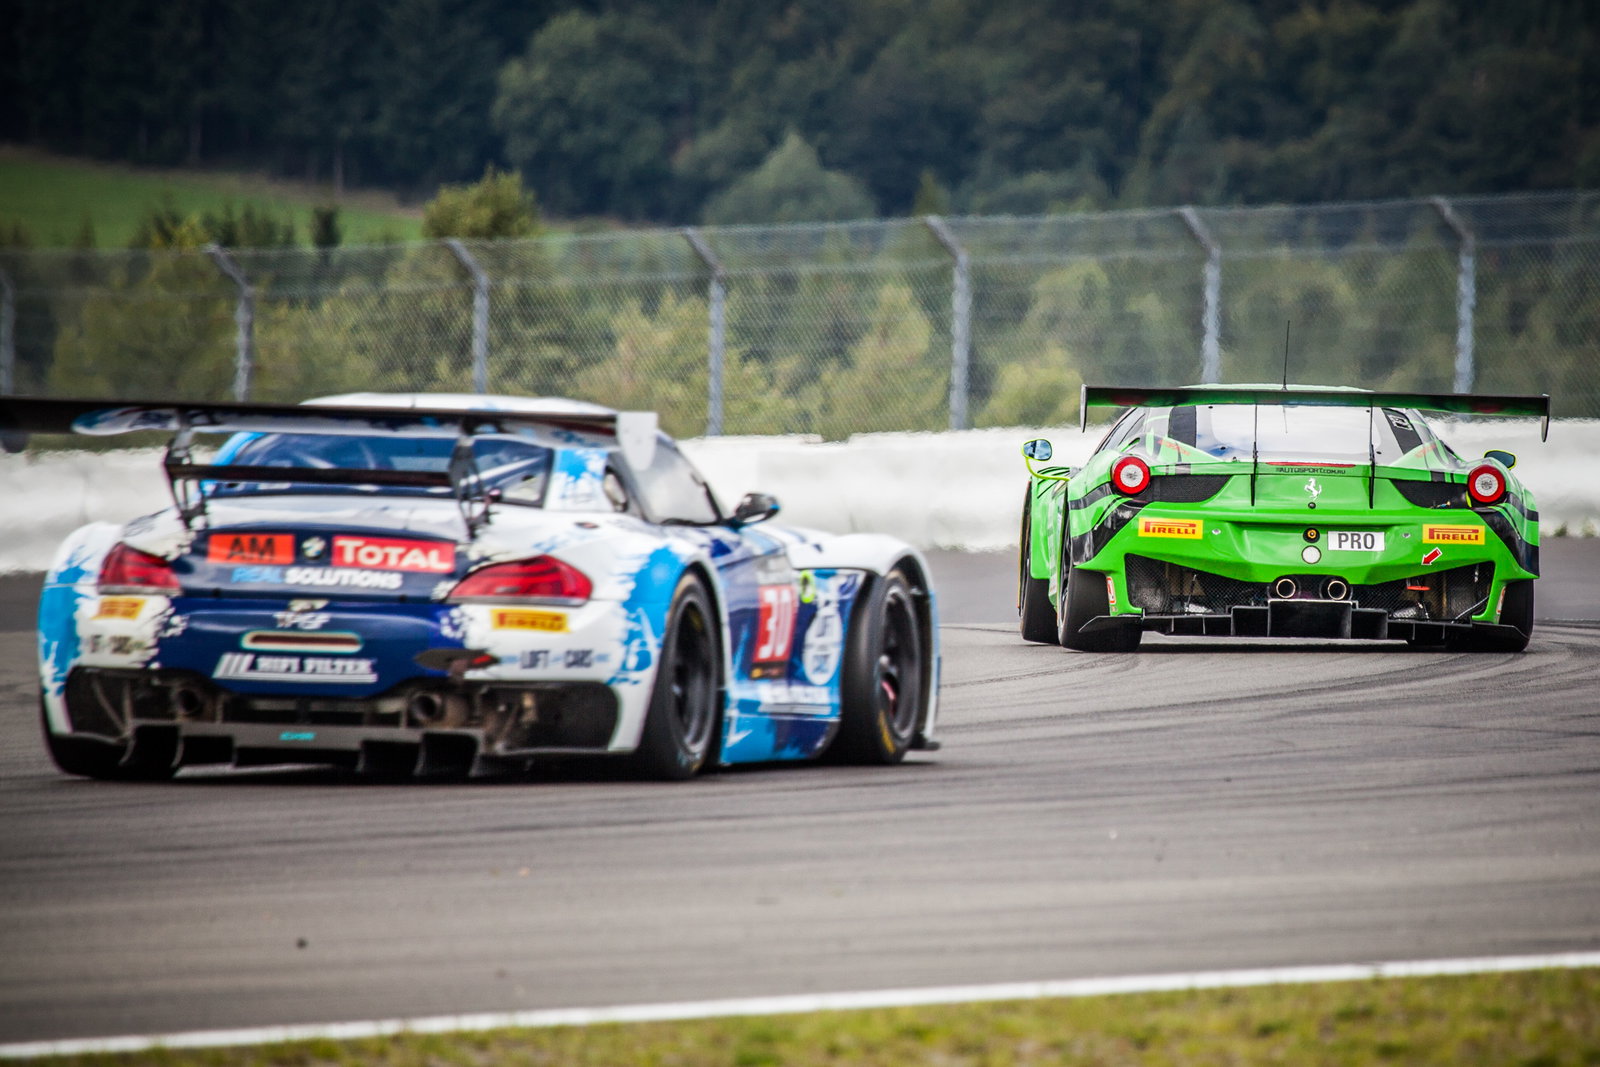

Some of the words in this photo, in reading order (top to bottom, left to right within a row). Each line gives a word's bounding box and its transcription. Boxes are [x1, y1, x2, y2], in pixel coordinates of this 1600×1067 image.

[1144, 521, 1196, 535] PIRELLI
[1428, 528, 1479, 541] PIRELLI
[227, 537, 276, 560] AM
[1337, 533, 1375, 549] PRO
[337, 539, 452, 569] TOTAL
[758, 589, 792, 659] 30
